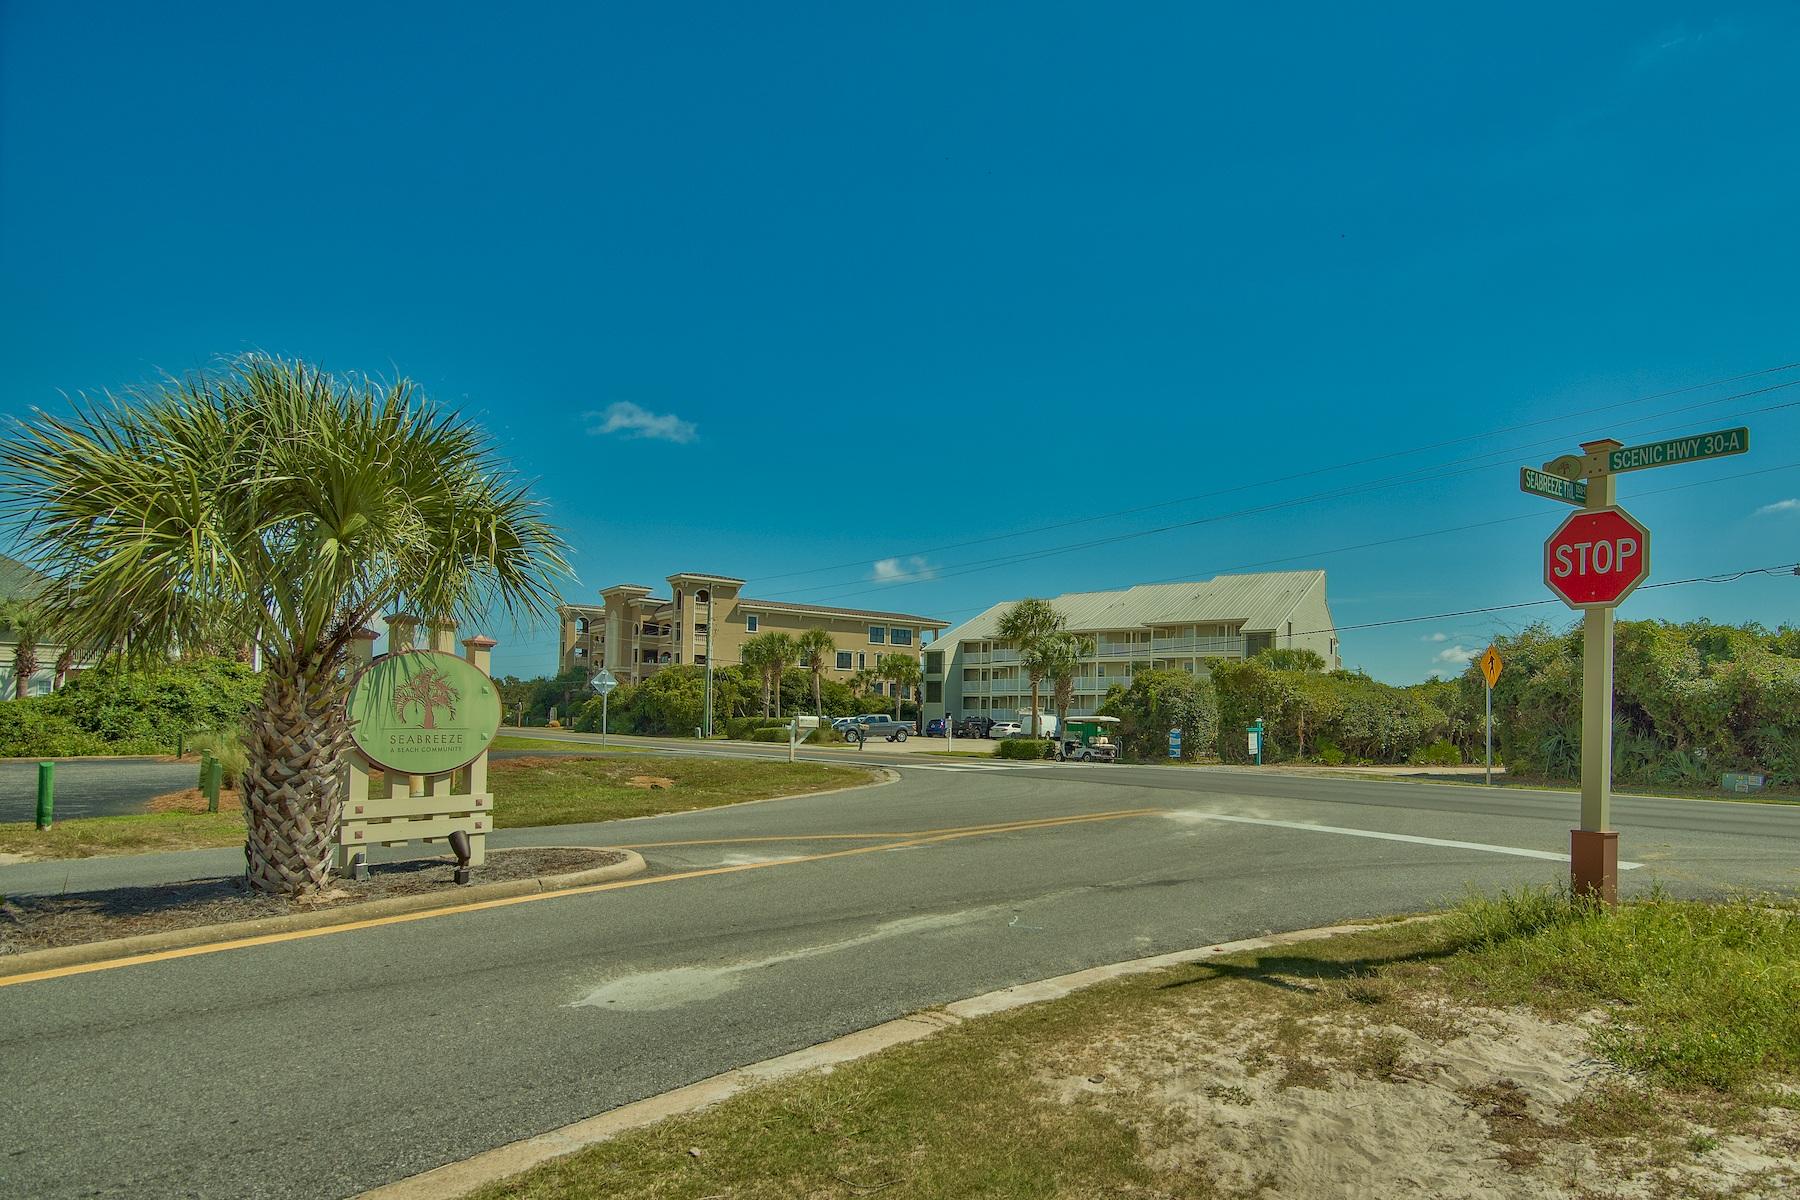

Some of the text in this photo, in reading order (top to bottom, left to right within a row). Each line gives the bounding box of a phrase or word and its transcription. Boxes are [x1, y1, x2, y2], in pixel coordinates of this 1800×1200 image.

[1613, 431, 1740, 470] SCENIC HWY 30-A
[1525, 470, 1563, 497] SEABREEZE
[1554, 537, 1637, 578] STOP
[390, 734, 463, 744] SEABREEZE
